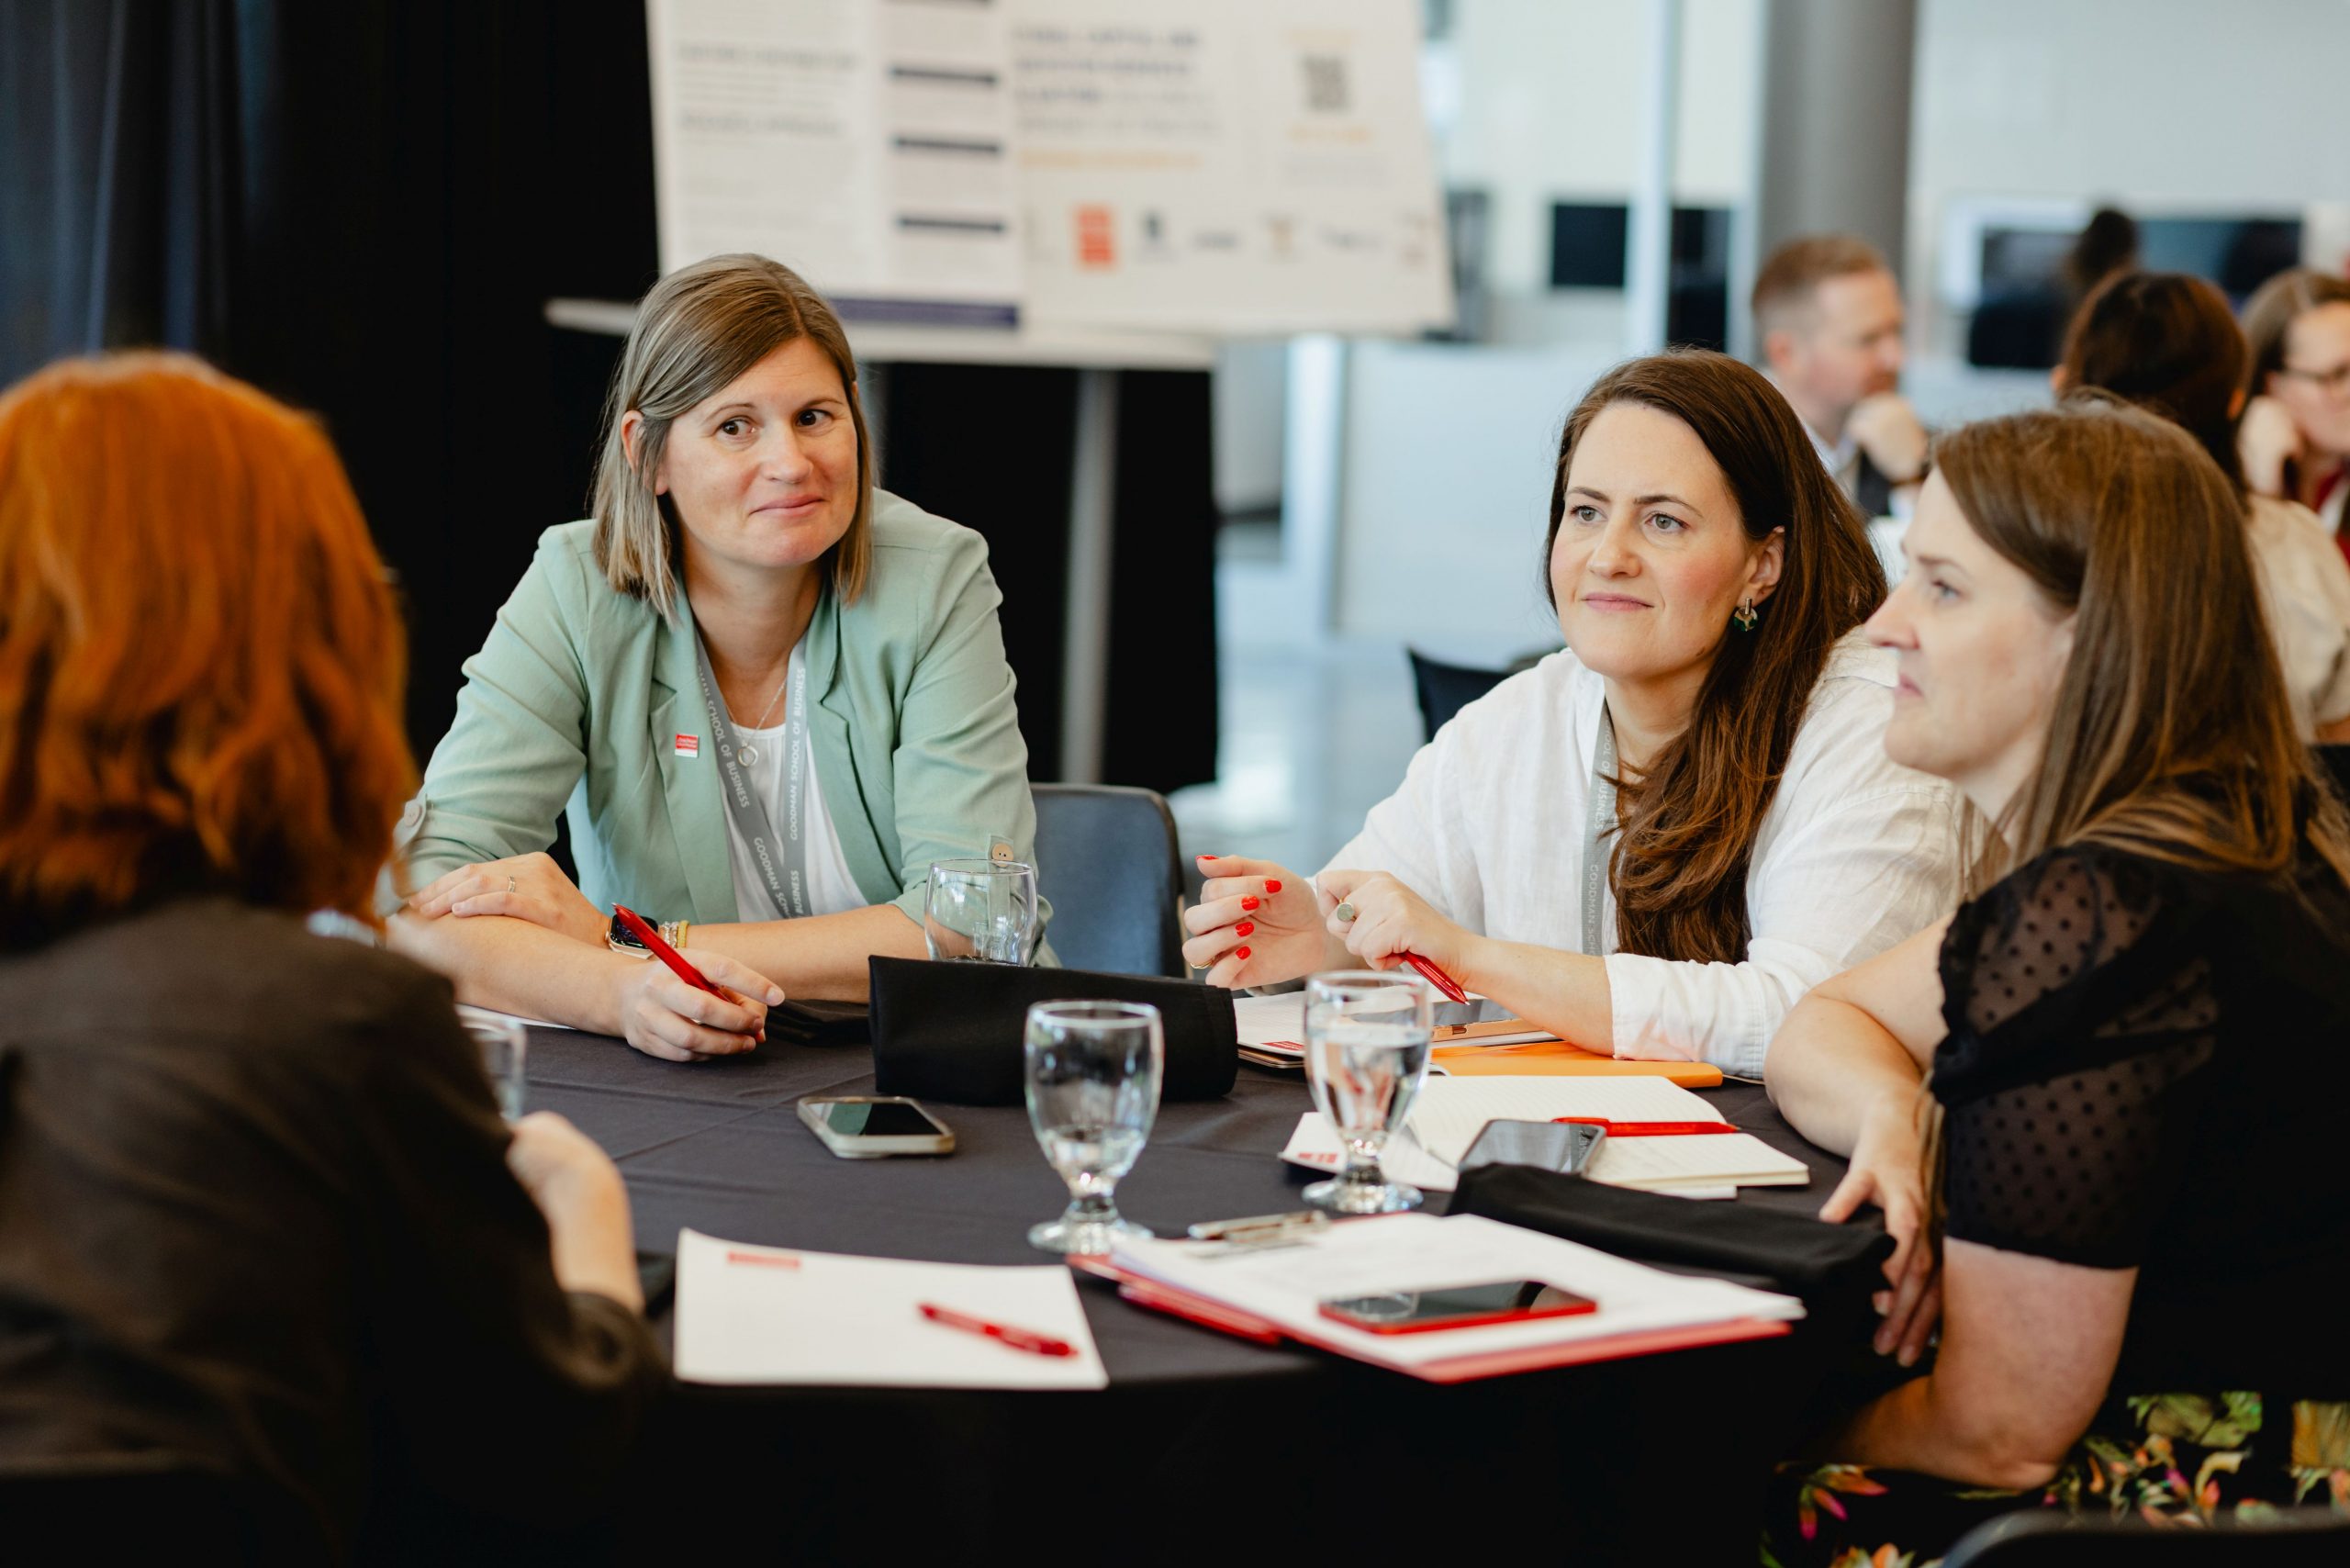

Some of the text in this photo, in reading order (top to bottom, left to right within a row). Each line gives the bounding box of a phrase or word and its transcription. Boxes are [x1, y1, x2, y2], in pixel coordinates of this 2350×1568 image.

[708, 700, 750, 808] SCHOOL OF BUSINESS
[789, 667, 806, 840] GOODMAN SCHOOL OF BUSINESS
[754, 837, 781, 890] GOODMAN
[790, 869, 804, 913] BUSINESS
[1588, 864, 1599, 924] GOODMAN
